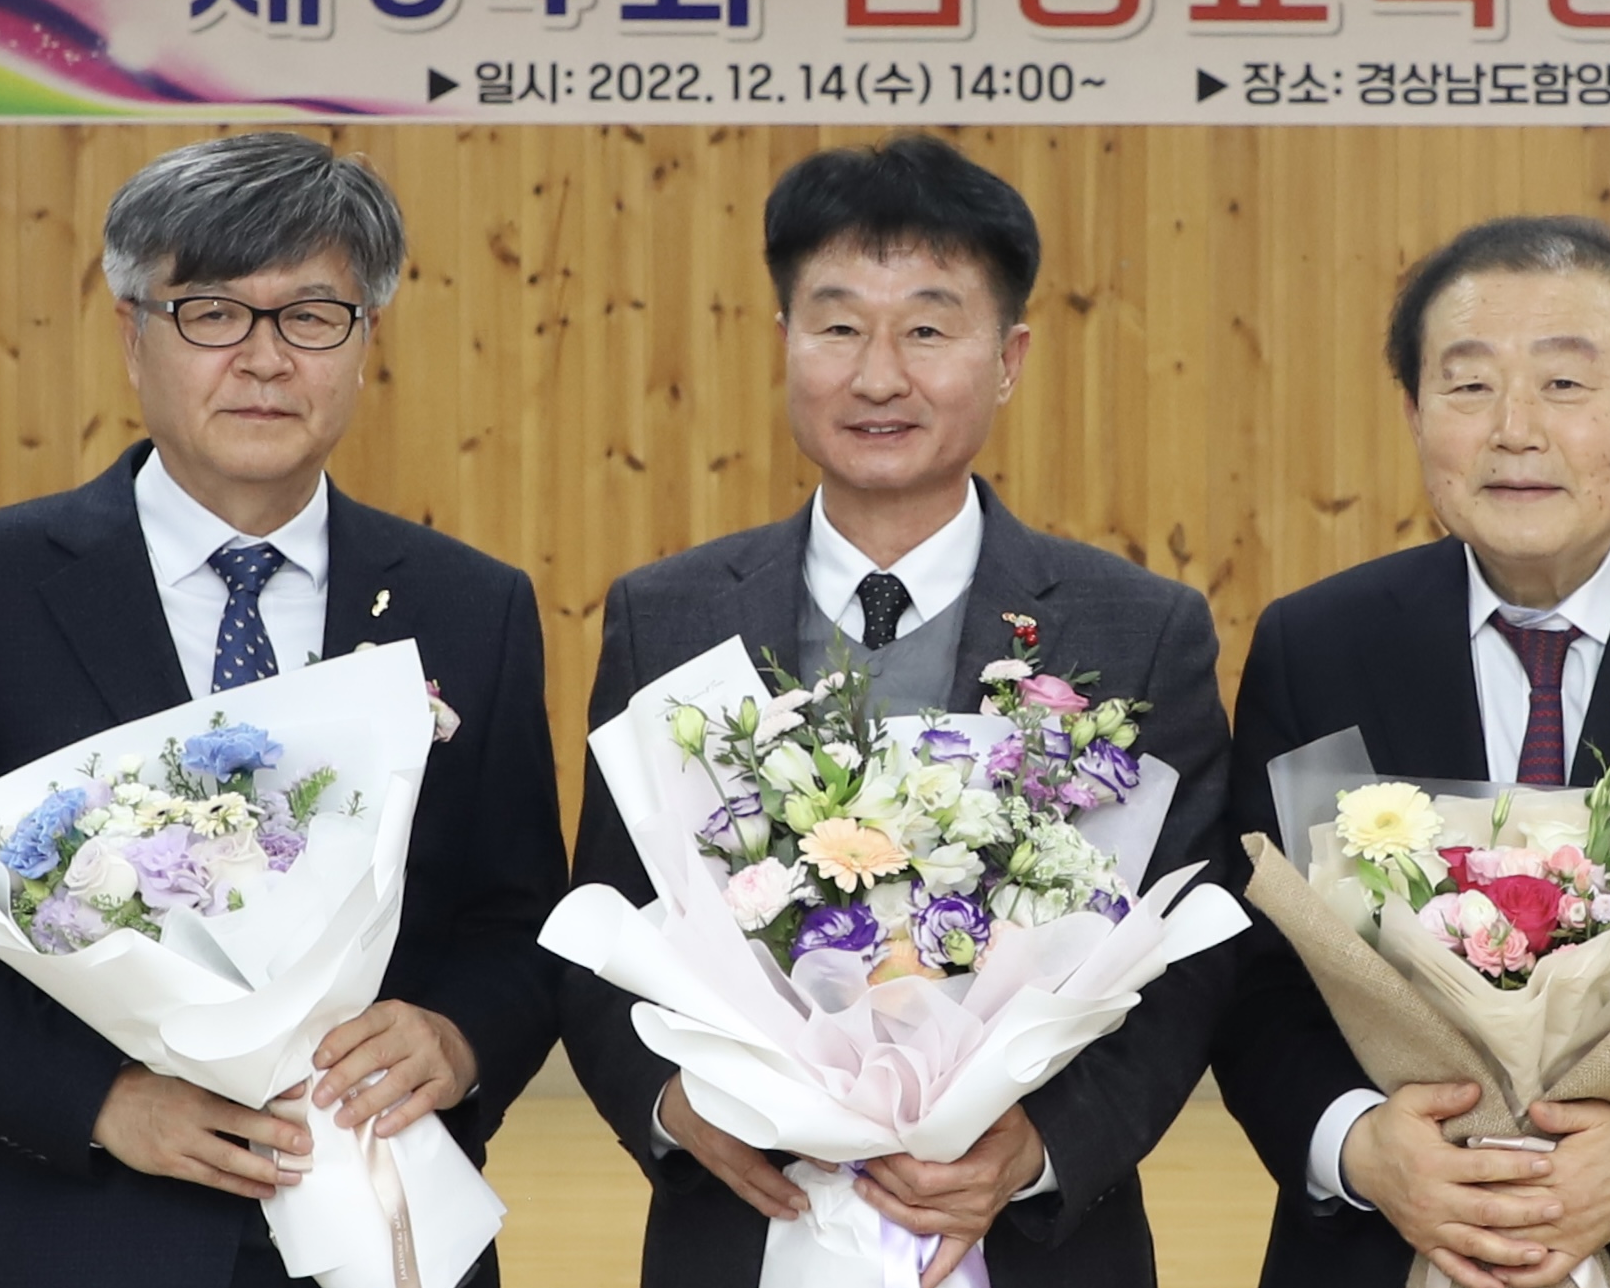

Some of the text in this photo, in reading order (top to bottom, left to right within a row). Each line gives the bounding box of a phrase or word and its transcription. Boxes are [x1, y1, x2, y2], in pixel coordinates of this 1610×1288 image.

[475, 62, 574, 104] 일시:
[951, 63, 1106, 102] 14:00~
[1244, 63, 1342, 105] 장소:
